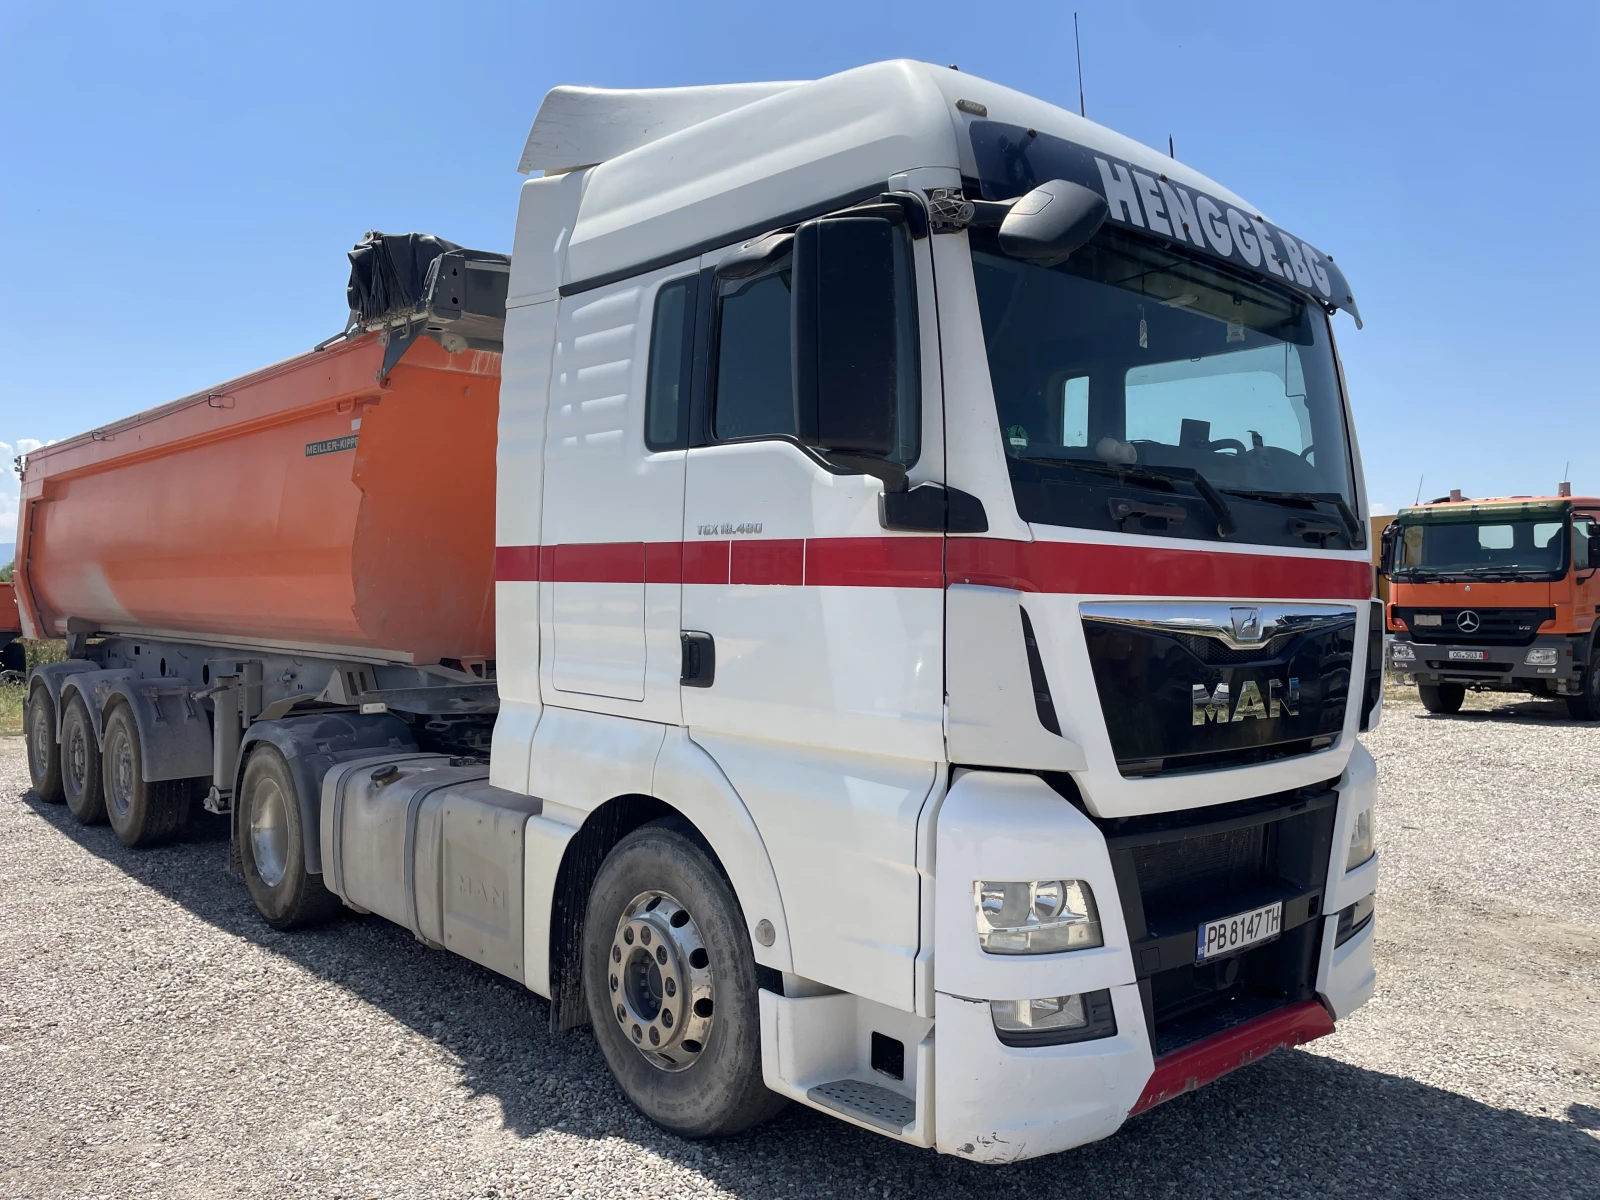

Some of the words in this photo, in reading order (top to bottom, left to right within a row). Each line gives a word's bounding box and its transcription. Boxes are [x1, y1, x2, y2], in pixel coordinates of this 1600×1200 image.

[1094, 157, 1331, 297] HENGGE.BG
[697, 524, 719, 536] TGX
[1192, 677, 1300, 726] MAN
